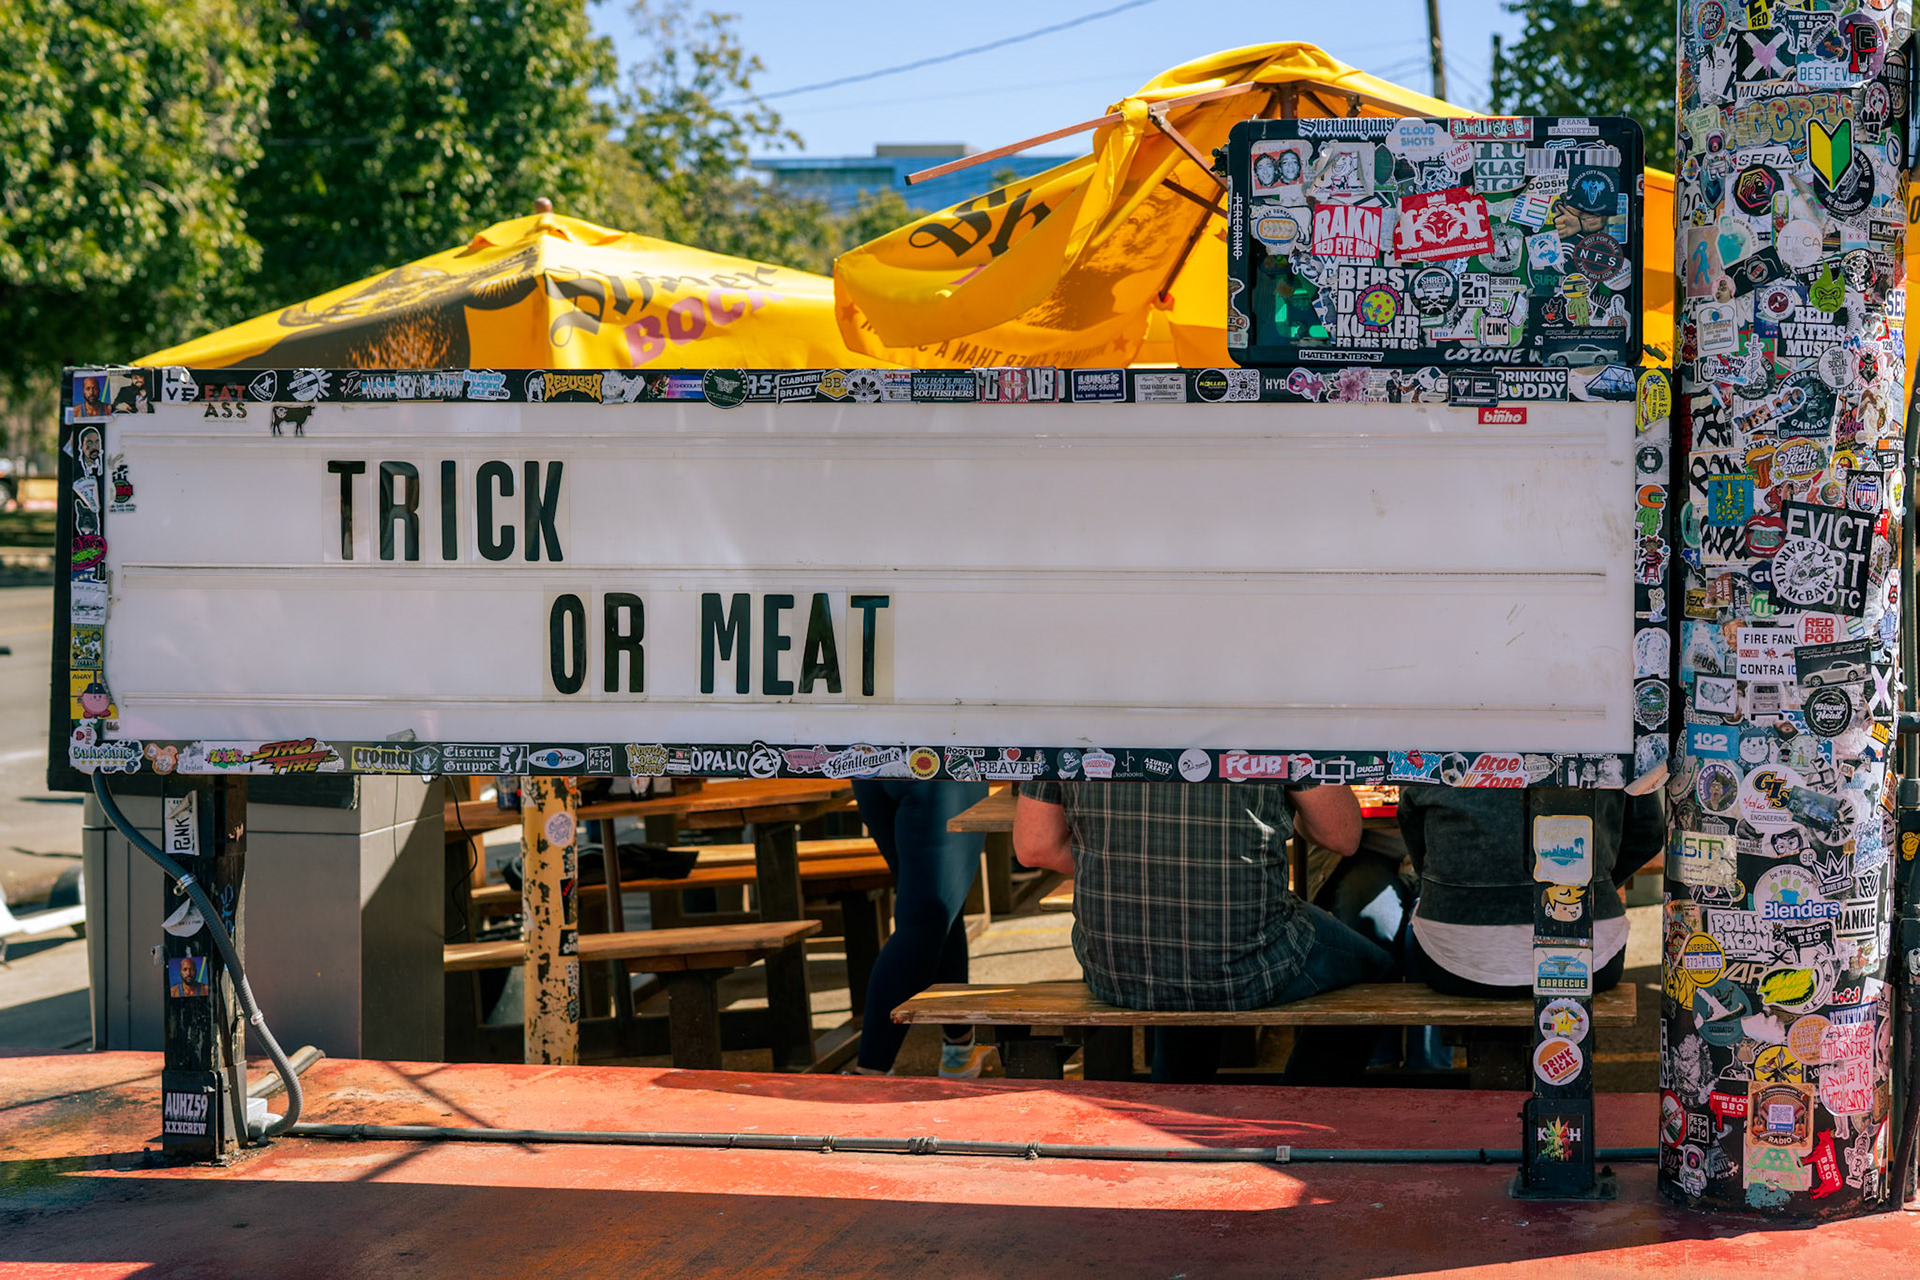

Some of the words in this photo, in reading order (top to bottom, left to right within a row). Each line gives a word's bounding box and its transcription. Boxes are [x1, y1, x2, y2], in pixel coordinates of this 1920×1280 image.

[1751, 12, 1768, 27] RED
[1400, 127, 1435, 135] CLOUD
[1401, 138, 1435, 147] SHOTS
[1450, 142, 1469, 157] LIKE
[1451, 154, 1471, 167] YOU!
[1314, 240, 1335, 254] RED
[1336, 239, 1354, 254] EYE
[1355, 240, 1377, 258] MOB
[1461, 282, 1487, 298] Zn
[1487, 322, 1508, 336] ZINC
[1779, 322, 1847, 340] WATERS
[1881, 341, 1894, 350] 129
[780, 374, 820, 386] CIABURRI
[1496, 371, 1566, 382] DRINKING
[204, 385, 246, 401] EAT
[468, 388, 487, 397] your
[487, 389, 509, 398] smile
[780, 387, 812, 398] BRAND
[913, 390, 974, 398] SOUTHSIDERS
[1498, 383, 1566, 399] BUDDY
[1483, 408, 1522, 423] binho
[1790, 417, 1829, 431] GARAGE
[1786, 461, 1818, 475] Nails
[327, 461, 564, 560] TRICK
[1787, 508, 1870, 552] EVICT
[1805, 617, 1835, 627] RED
[551, 593, 646, 694] OR
[702, 593, 891, 695] MEAT
[1744, 634, 1768, 644] FIRE
[1805, 634, 1835, 644] POD
[1740, 664, 1784, 676] CONTRA
[1814, 703, 1846, 712] Biscuit
[1816, 710, 1843, 722] Head
[443, 746, 495, 758] Eiserne
[947, 748, 984, 756] ROOSTER
[443, 760, 494, 774] Gruppe
[829, 749, 900, 775] Gentlemen's
[977, 761, 1041, 774] BEAVER
[1356, 765, 1385, 773] DUCATI
[1749, 812, 1788, 823] ENGINEERING
[1762, 901, 1840, 920] Blenders
[1786, 929, 1806, 938] TERRY
[1797, 933, 1822, 943] BBQ
[1714, 932, 1771, 952] BACON
[1540, 978, 1586, 988] BARBECUE
[1541, 1047, 1572, 1072] DRINK
[1547, 1056, 1579, 1079] LOCAL
[1712, 1094, 1730, 1102] TERRY
[1721, 1102, 1745, 1112] BBQ
[164, 1121, 207, 1135] XXXCREW
[1767, 1136, 1793, 1146] RADIO
[1820, 1156, 1833, 1180] BBQ
